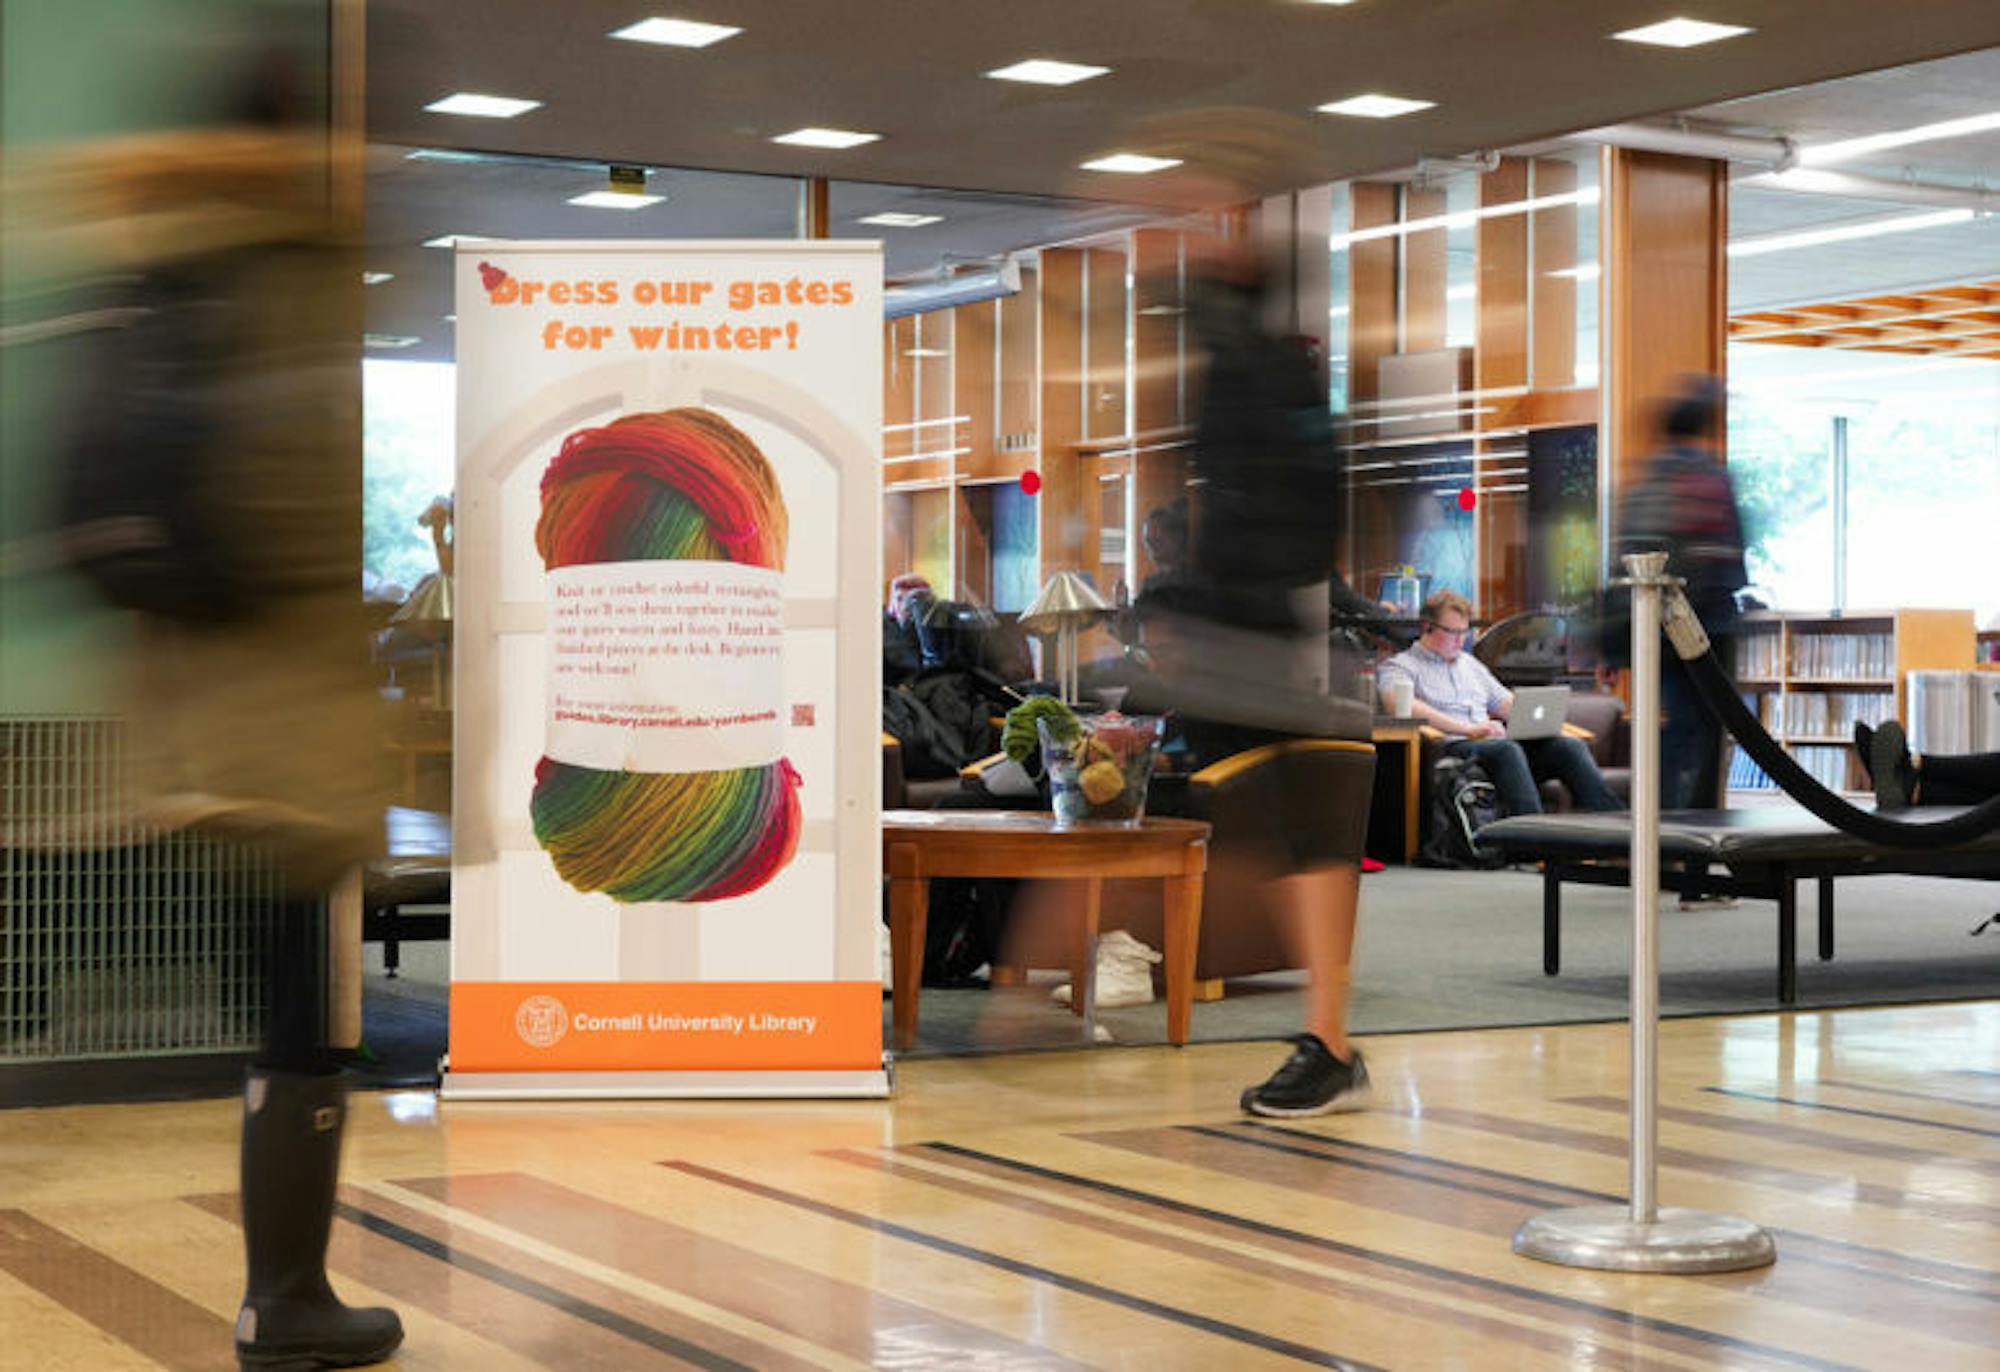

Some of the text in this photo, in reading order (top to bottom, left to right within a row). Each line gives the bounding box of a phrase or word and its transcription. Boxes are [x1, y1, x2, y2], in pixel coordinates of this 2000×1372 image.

[489, 276, 853, 310] Dress our gates
[542, 321, 800, 350] for winter!
[557, 602, 579, 614] and
[640, 601, 673, 615] them
[660, 622, 683, 635] and
[727, 622, 763, 636] Hand
[573, 1013, 817, 1035] Cornell University Library
